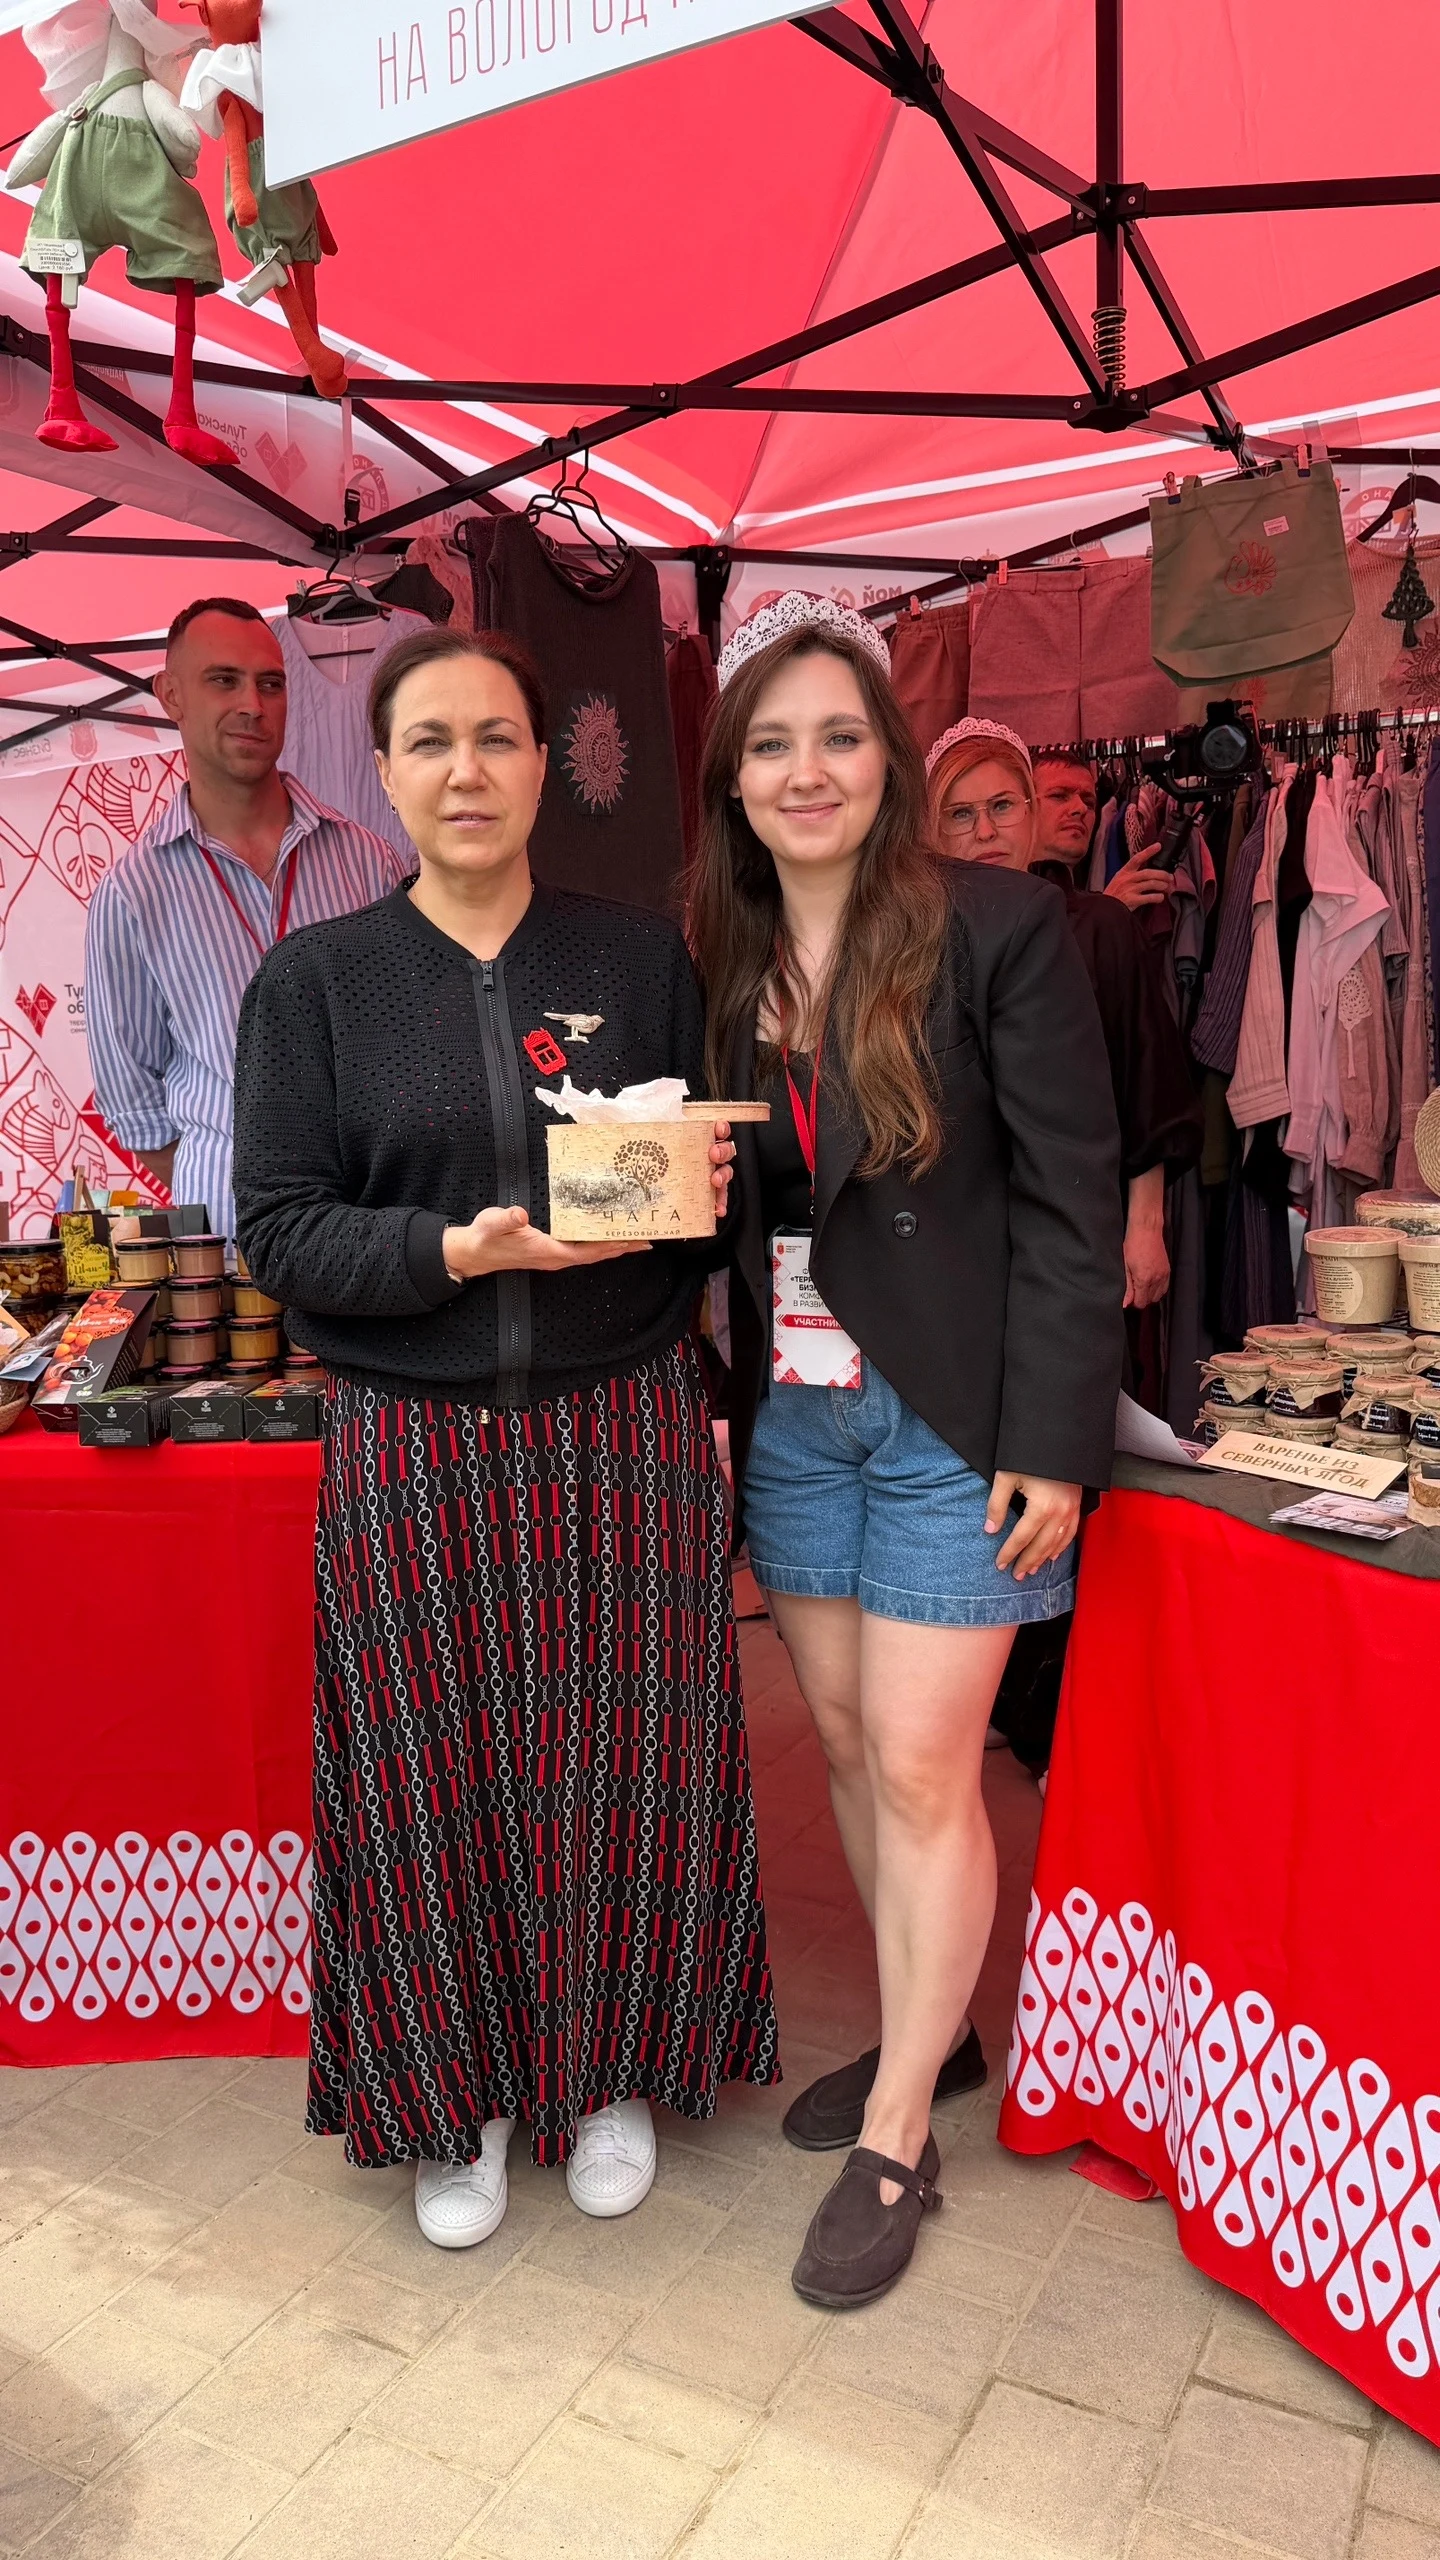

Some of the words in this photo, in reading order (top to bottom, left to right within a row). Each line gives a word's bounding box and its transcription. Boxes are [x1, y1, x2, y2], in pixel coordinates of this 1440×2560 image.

[378, 22, 428, 109] НА
[603, 1209, 681, 1222] ЧАГА
[1220, 1450, 1315, 1477] СЕВЕРНЫХ
[1314, 1466, 1371, 1489] ЯГОД
[1252, 1442, 1331, 1465] ВАРЕНЬЕ
[1331, 1457, 1360, 1471] ИЗ
